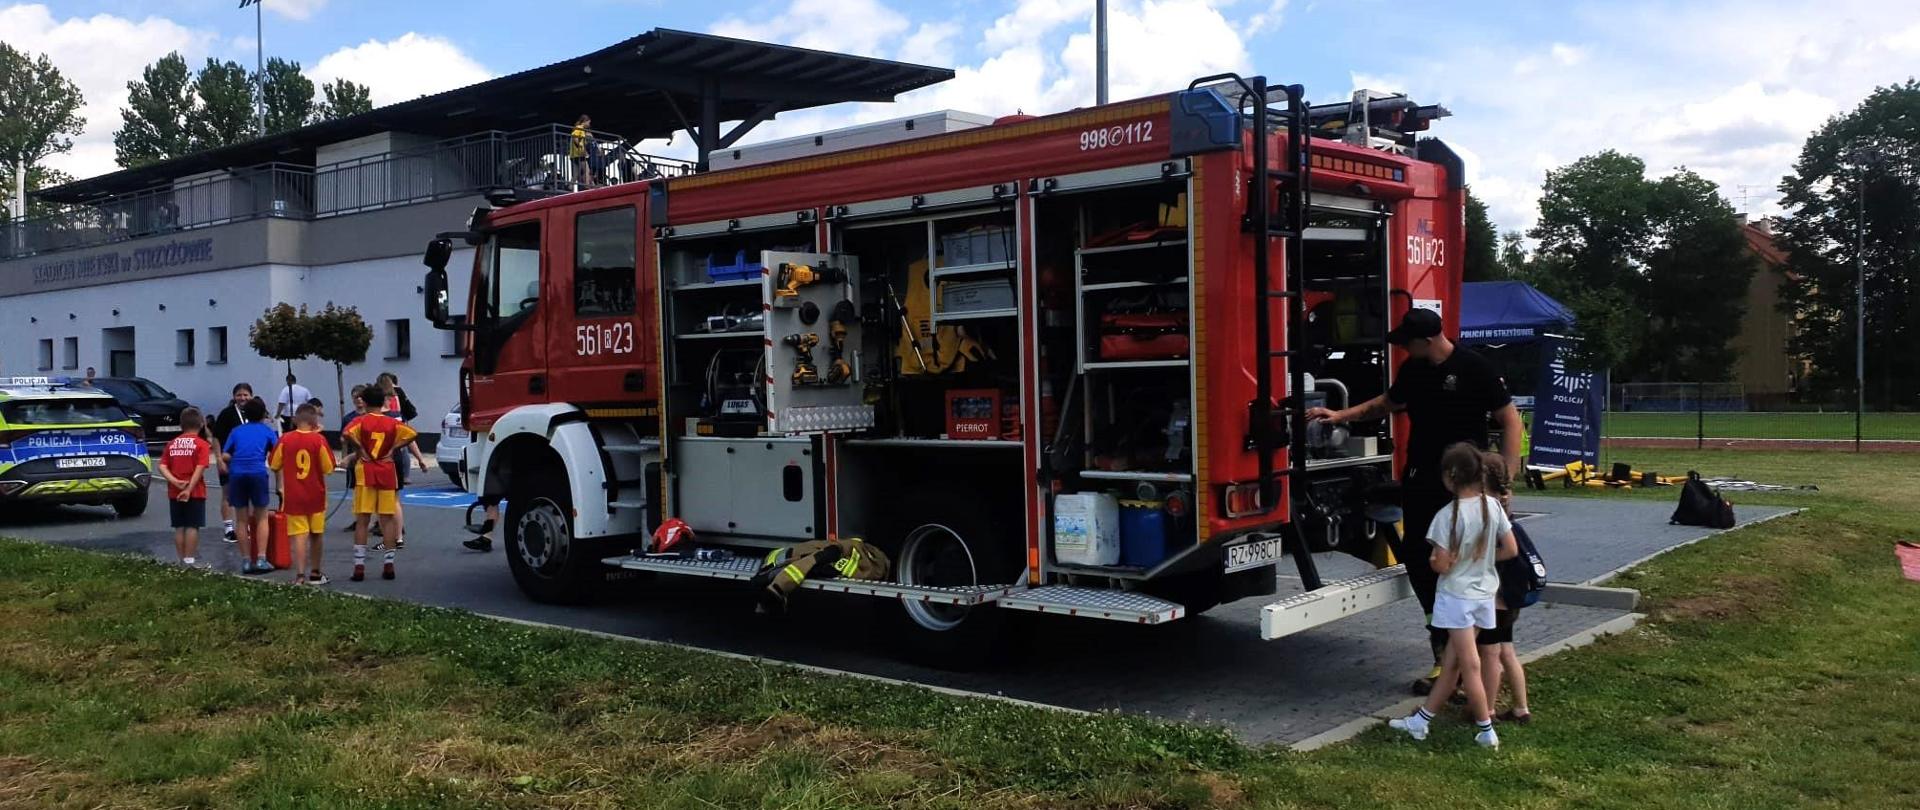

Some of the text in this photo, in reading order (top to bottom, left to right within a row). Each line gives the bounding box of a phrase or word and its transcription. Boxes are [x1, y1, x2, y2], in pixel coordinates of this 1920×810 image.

[1080, 121, 1153, 151] 998 112
[1460, 329, 1484, 338] POLICJI
[29, 434, 126, 447] POLICJA K950
[956, 423, 989, 433] PIERROT
[370, 432, 386, 459] 7
[295, 449, 311, 480] 9
[1232, 540, 1279, 567] RZ 998CT
